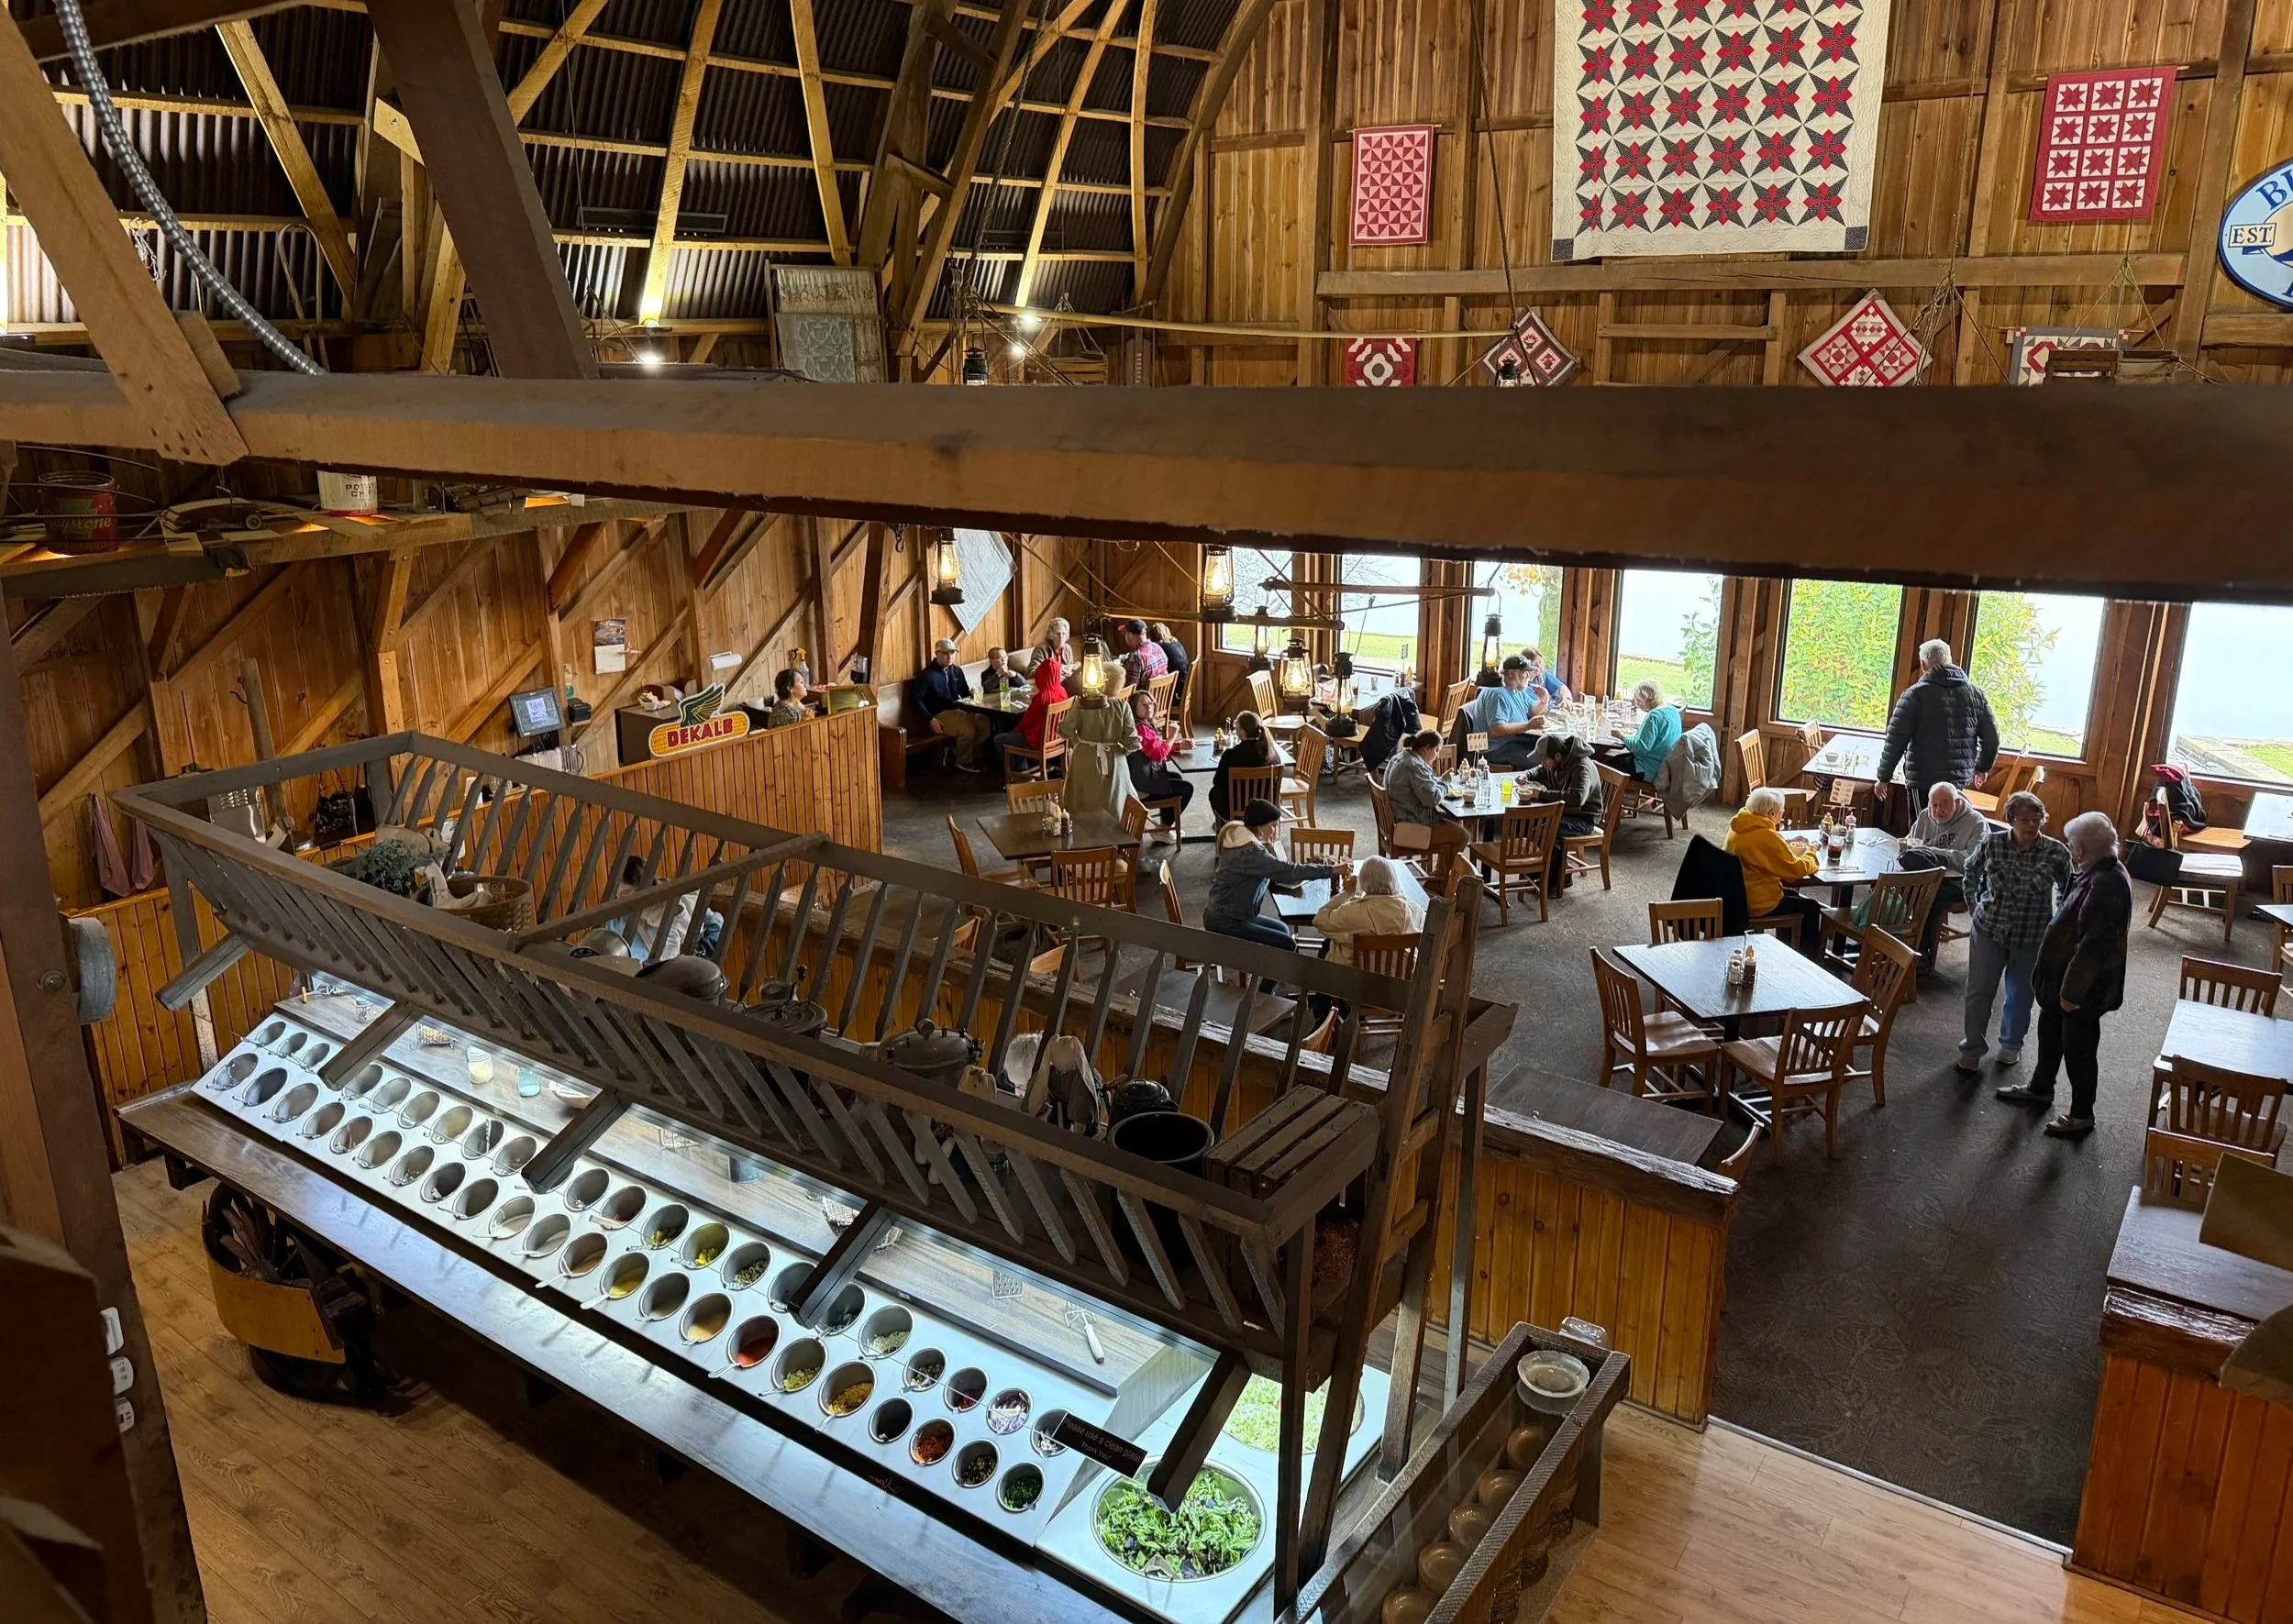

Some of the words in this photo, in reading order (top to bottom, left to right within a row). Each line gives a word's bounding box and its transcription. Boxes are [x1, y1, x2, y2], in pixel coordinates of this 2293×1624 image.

[2232, 226, 2273, 245] EST.
[667, 719, 733, 747] DEKALB
[1063, 1418, 1084, 1433] Please
[1086, 1431, 1098, 1441] use
[1104, 1438, 1124, 1453] clean
[1081, 1442, 1097, 1455] Thank
